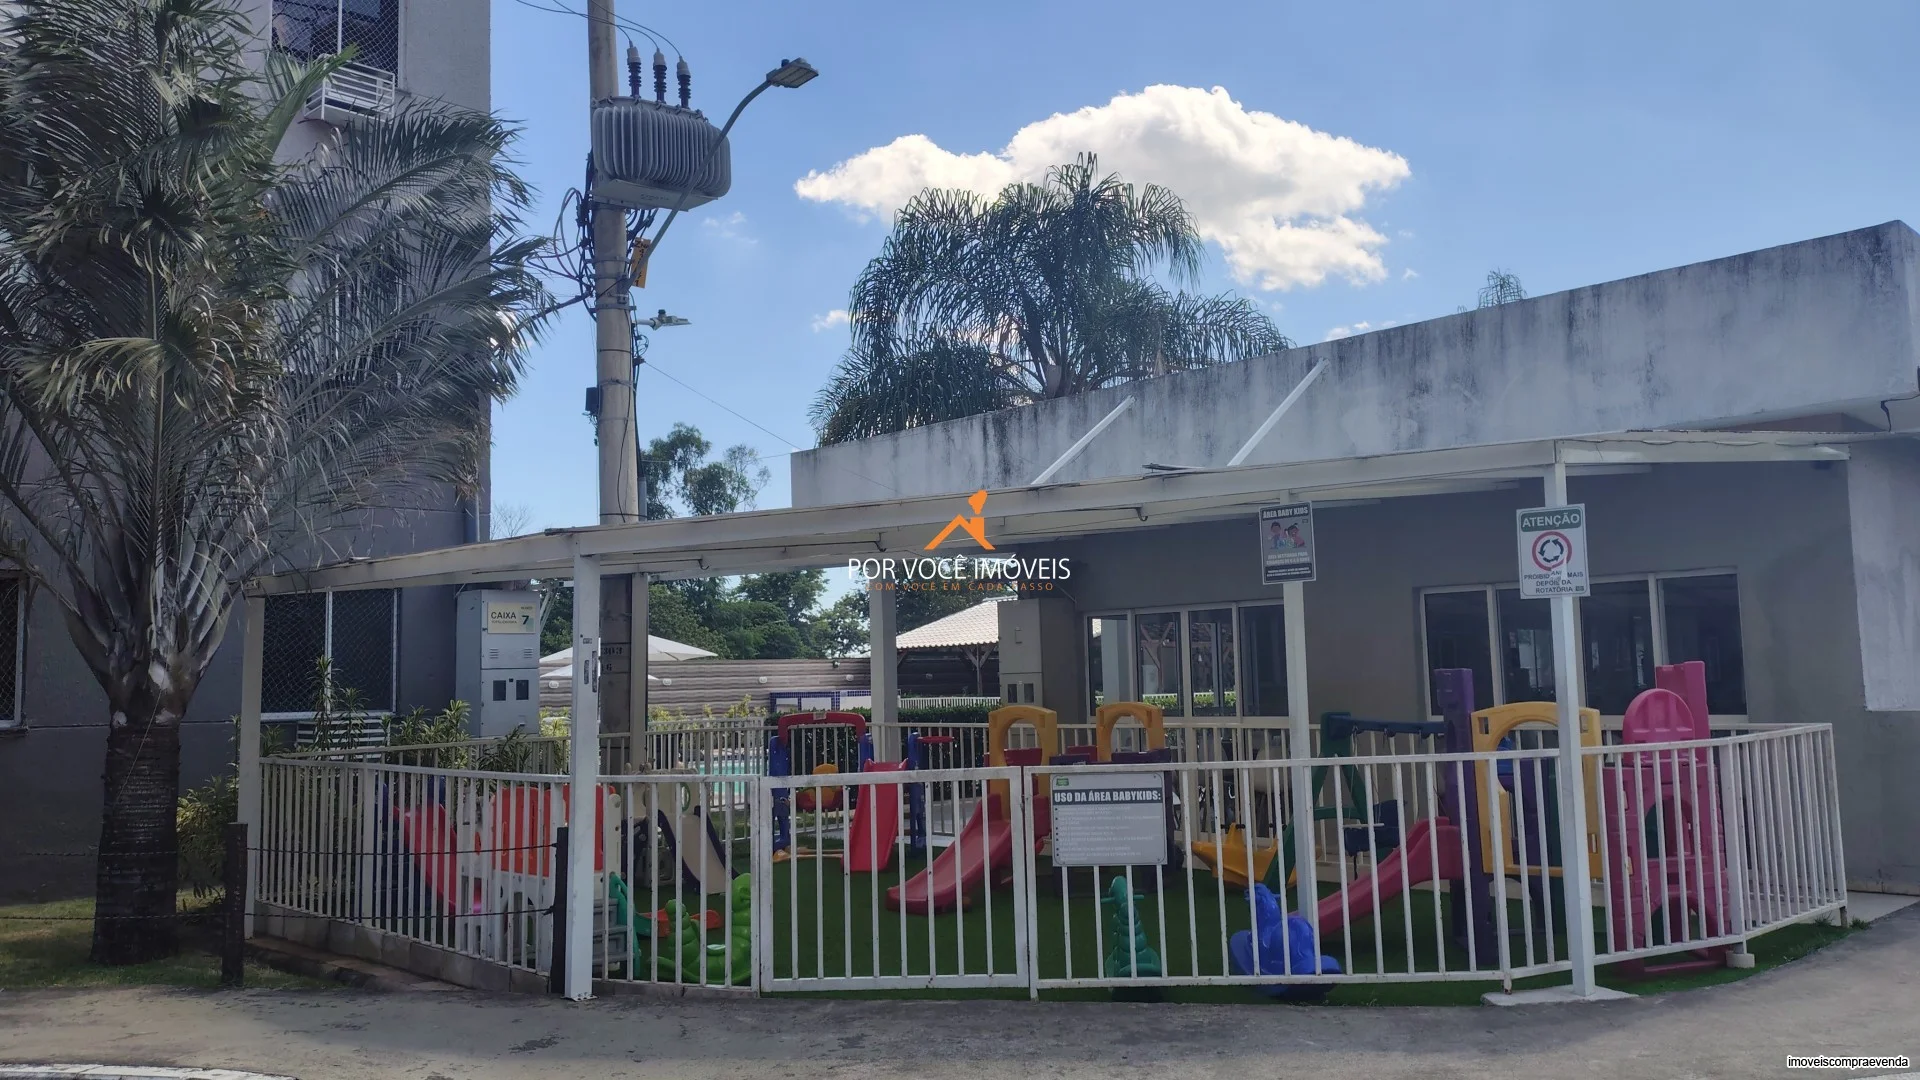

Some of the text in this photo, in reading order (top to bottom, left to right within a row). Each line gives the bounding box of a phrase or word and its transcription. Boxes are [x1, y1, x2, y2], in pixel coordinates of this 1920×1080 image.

[1293, 506, 1308, 515] KIDS
[1522, 512, 1580, 528] ATENÇÃO
[490, 611, 530, 625] CAIXA 7
[1054, 789, 1162, 803] USO DA ÁREA BABYKIDS:
